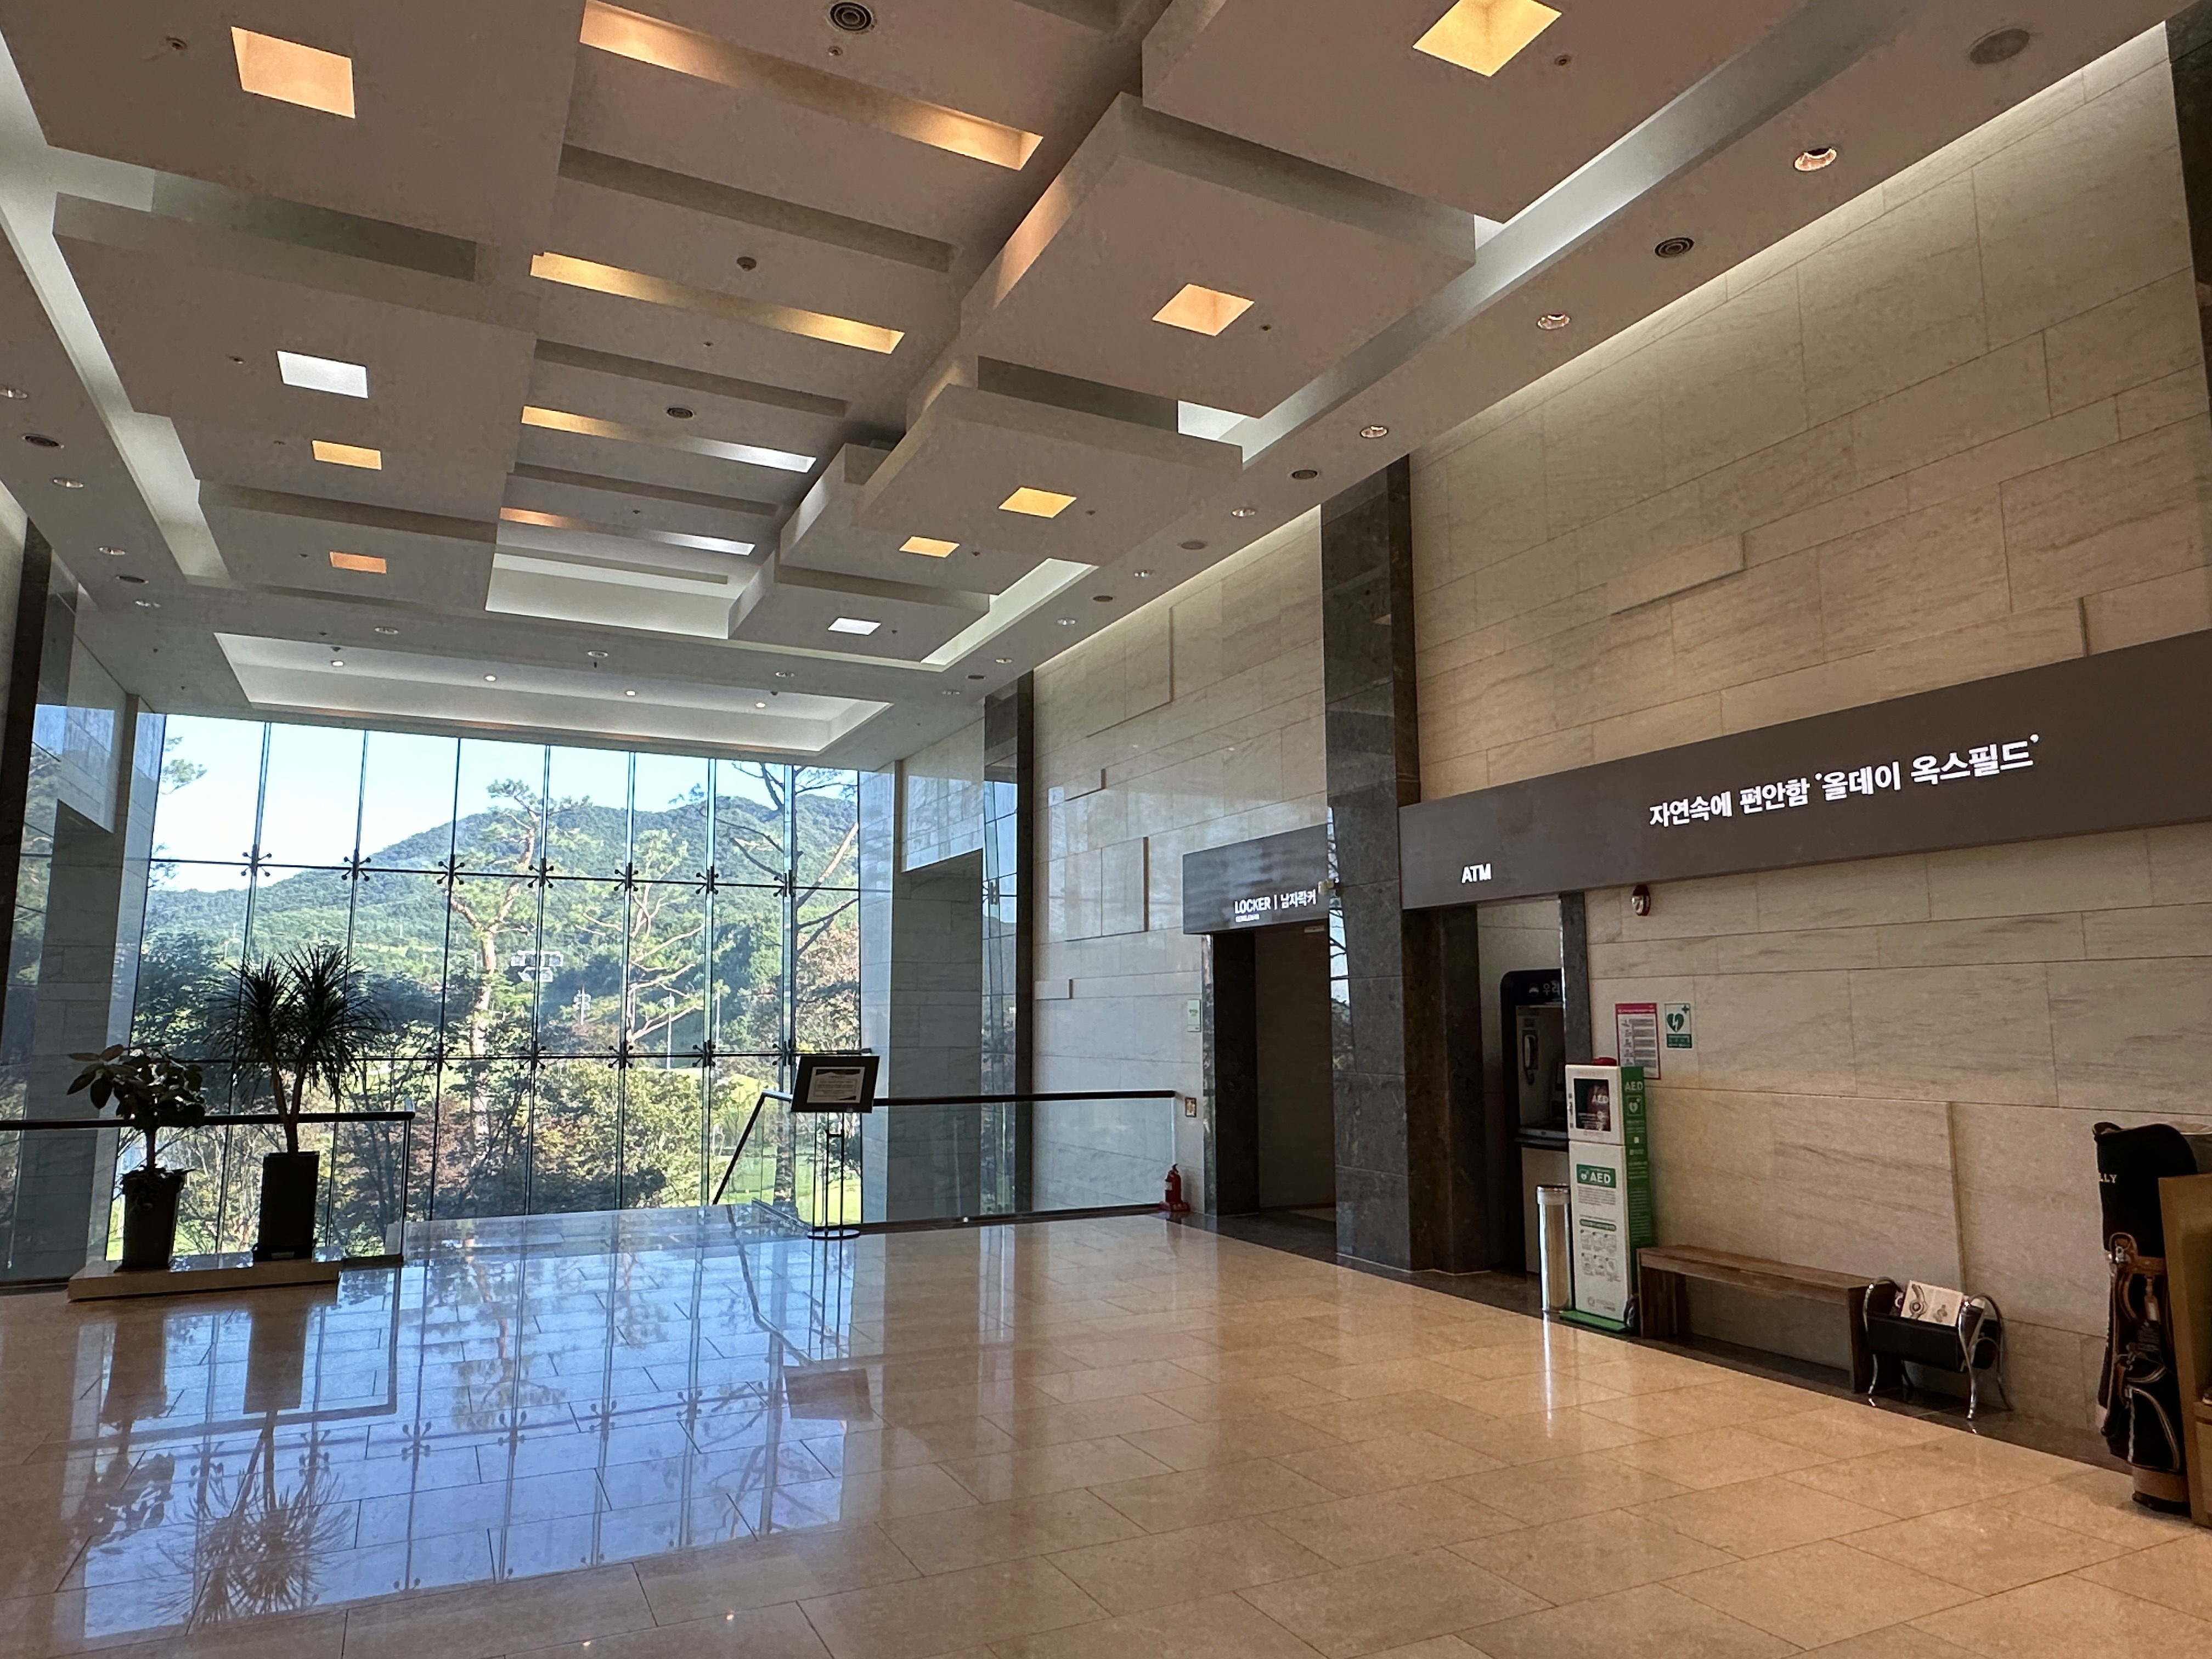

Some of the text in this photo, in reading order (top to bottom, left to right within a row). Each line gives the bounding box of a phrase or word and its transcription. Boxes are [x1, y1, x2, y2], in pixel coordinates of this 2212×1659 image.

[1650, 792, 1733, 827] 자연속에
[1740, 778, 1810, 814] 편안함
[1462, 863, 1491, 883] ATM
[1234, 896, 1271, 914] LOCKER
[1624, 1081, 1644, 1091] AED
[1590, 1172, 1611, 1184] AED
